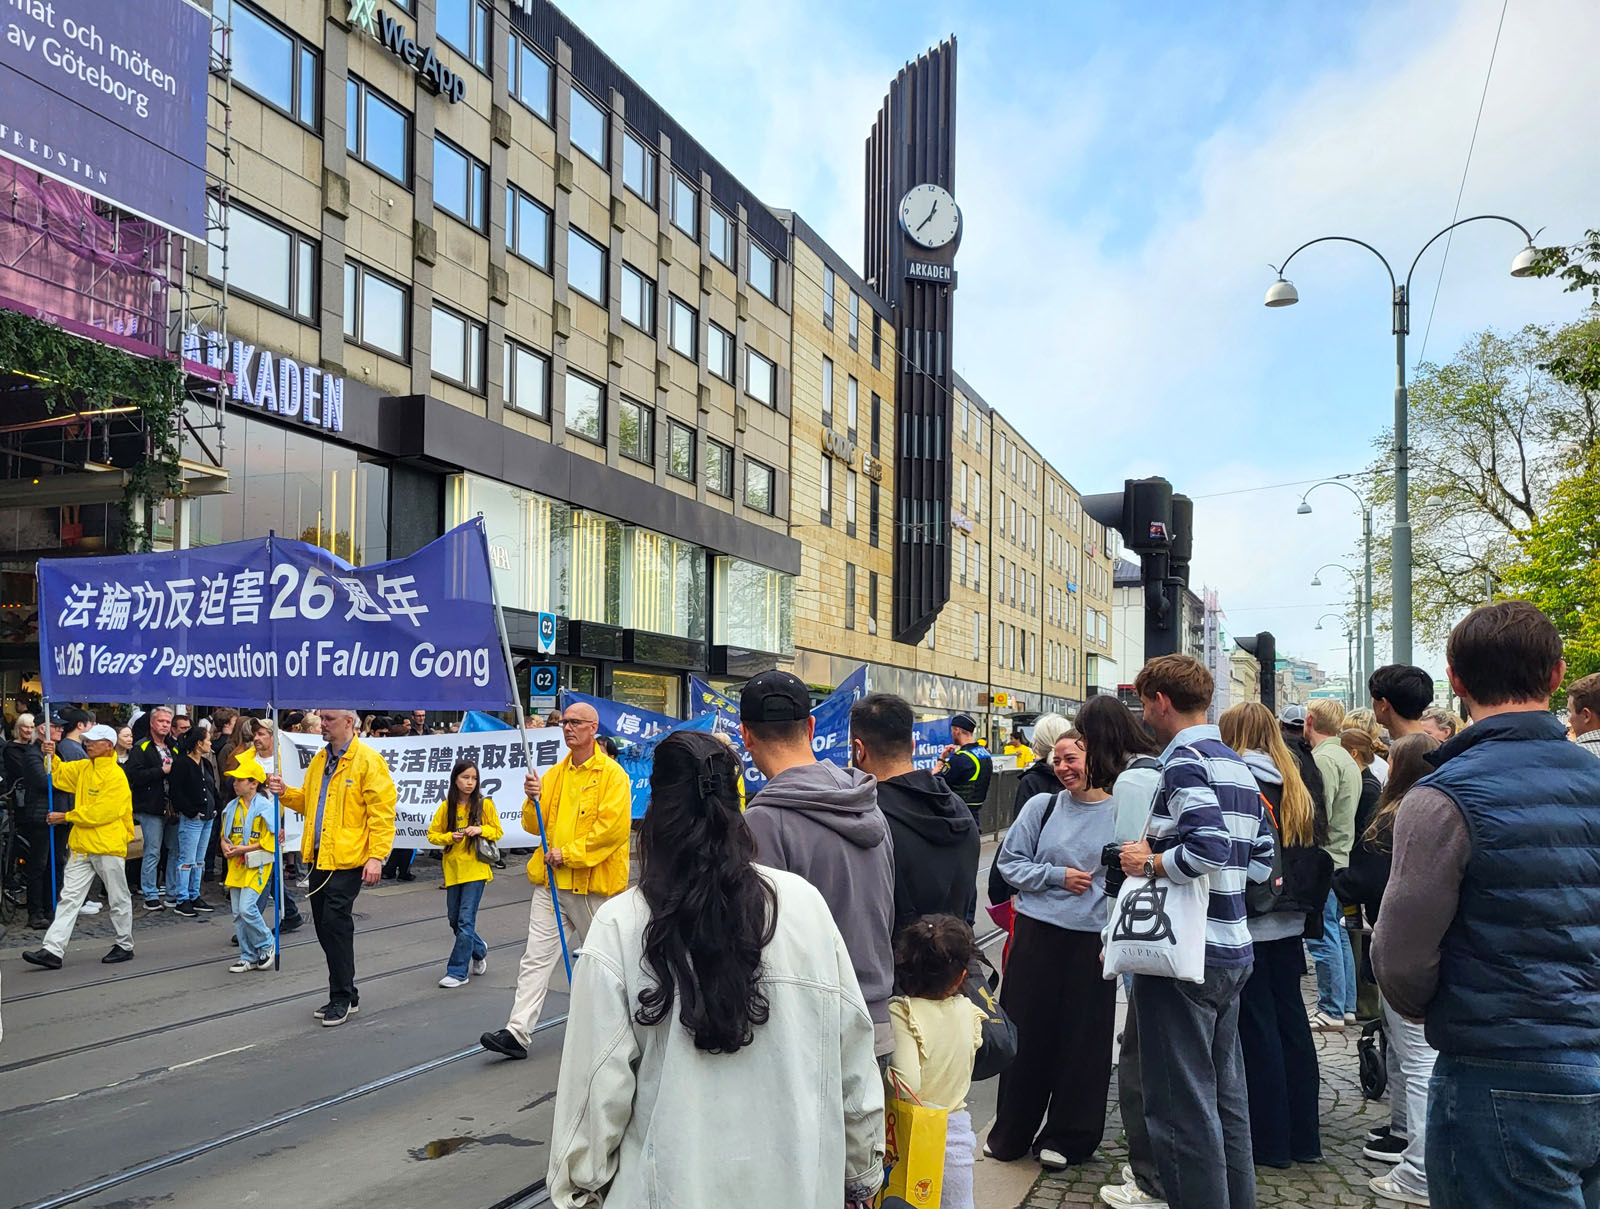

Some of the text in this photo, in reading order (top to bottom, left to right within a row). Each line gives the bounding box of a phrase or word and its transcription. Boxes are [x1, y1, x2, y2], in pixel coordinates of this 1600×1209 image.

[63, 18, 103, 55] och
[110, 43, 176, 95] möten
[7, 24, 149, 118] av Göteborg
[909, 262, 951, 280] ARKADEN
[489, 544, 511, 570] ARA
[542, 620, 553, 634] C2
[67, 642, 85, 676] 26
[153, 643, 278, 678] Persecution
[285, 640, 310, 678] of
[316, 640, 399, 678] Falun
[409, 641, 491, 688] Gong
[536, 673, 552, 687] C2
[616, 711, 671, 740] 停止
[811, 732, 837, 752] OF
[401, 812, 427, 824] Party
[500, 810, 523, 820] orga
[408, 826, 428, 836] Gon
